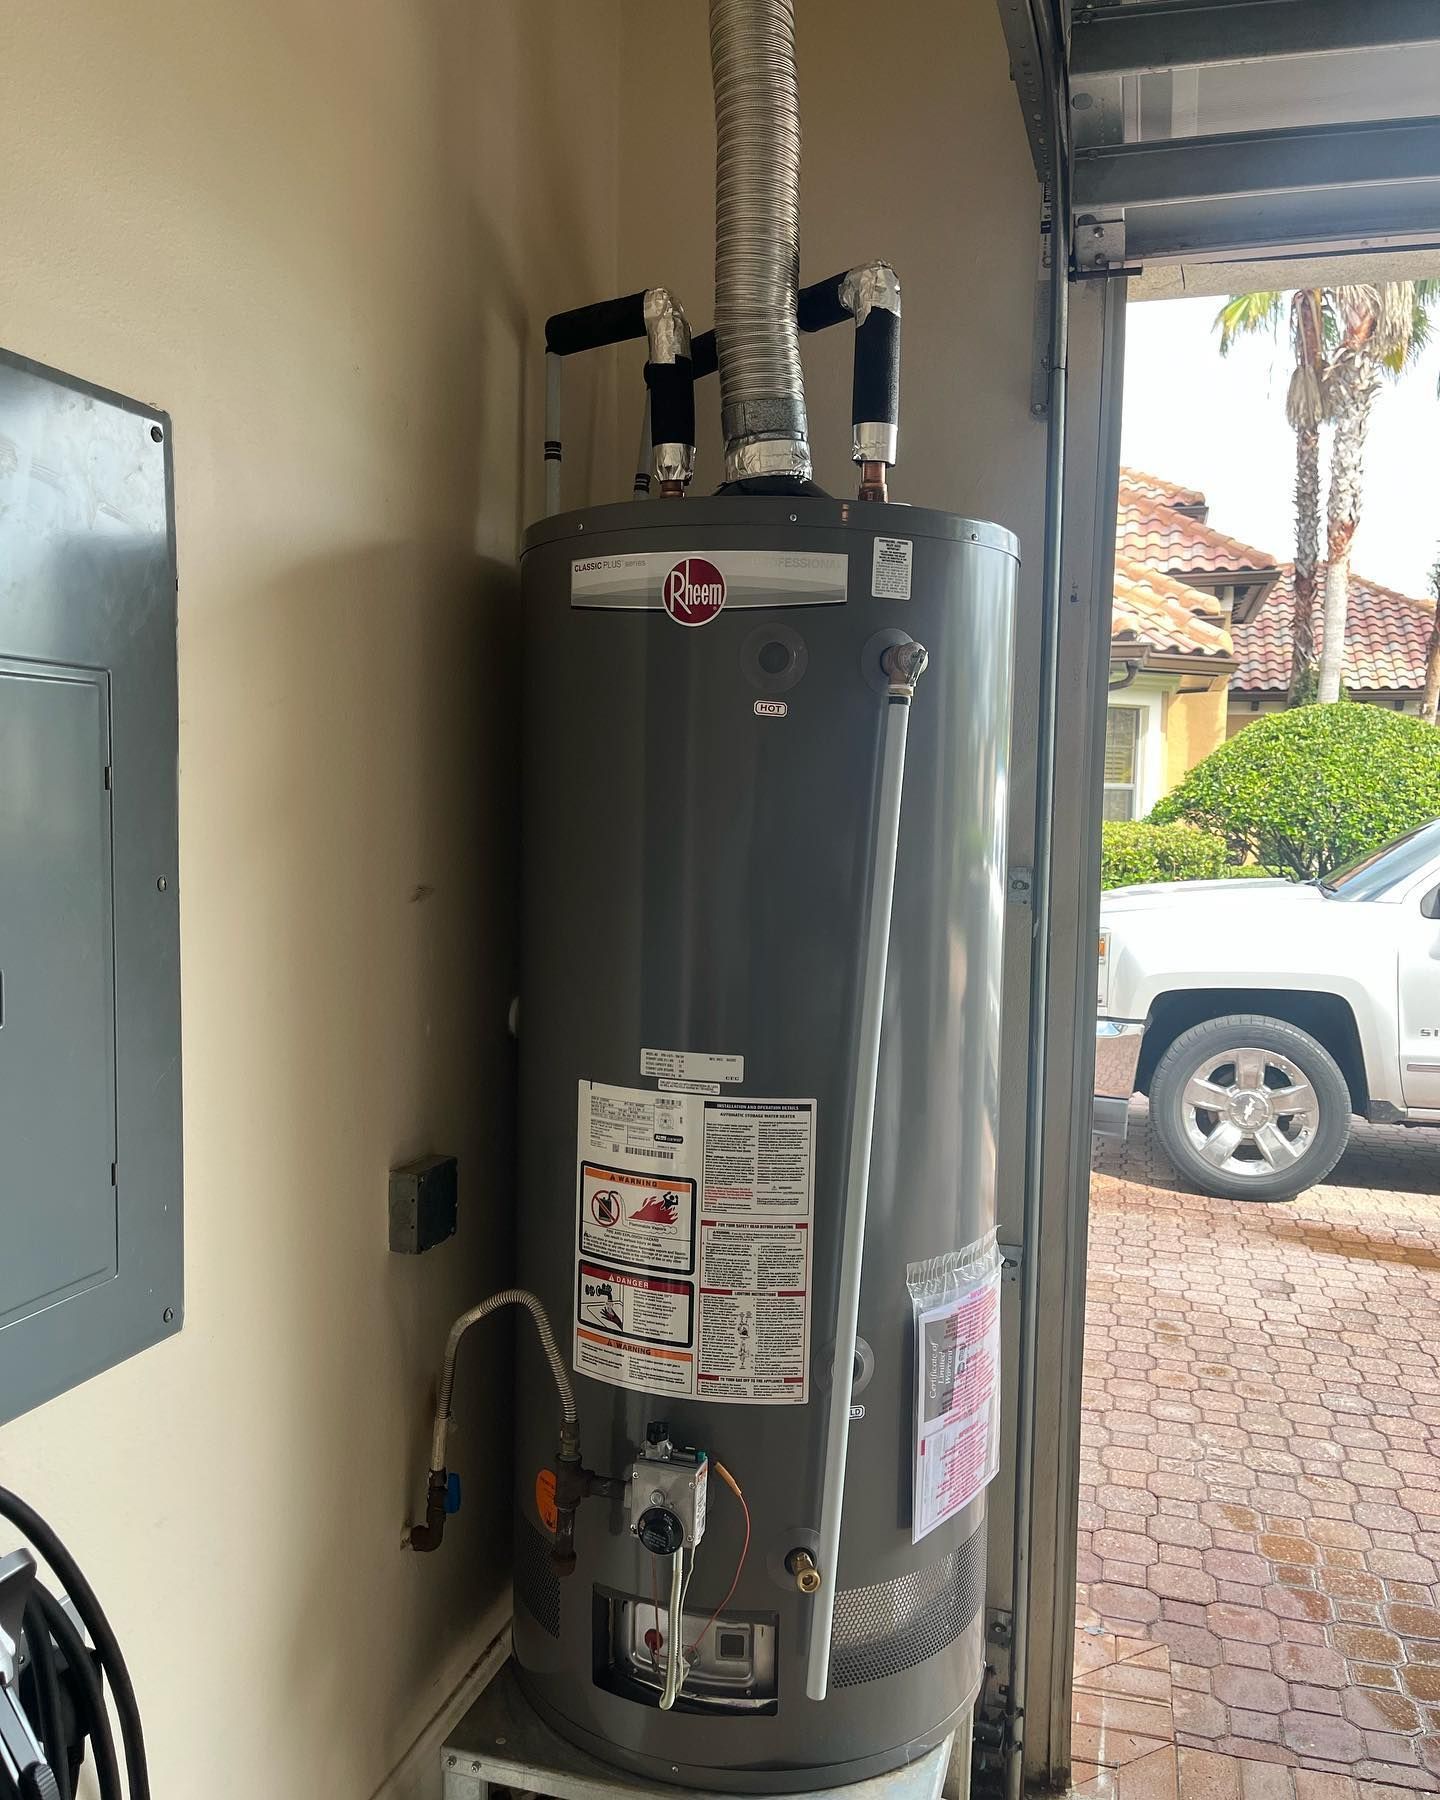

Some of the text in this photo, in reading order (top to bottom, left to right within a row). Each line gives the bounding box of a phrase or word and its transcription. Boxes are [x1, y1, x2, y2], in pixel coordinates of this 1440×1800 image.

[574, 561, 603, 573] CLASSIC
[603, 560, 622, 569] PLUS
[670, 559, 722, 615] Rheem
[760, 704, 782, 713] HOT
[618, 1175, 657, 1188] WARNING
[616, 1276, 650, 1289] DANGER
[616, 1341, 651, 1356] WARNING
[929, 1341, 939, 1399] Certificate of
[938, 1351, 946, 1384] Limited
[850, 1408, 862, 1416] LD
